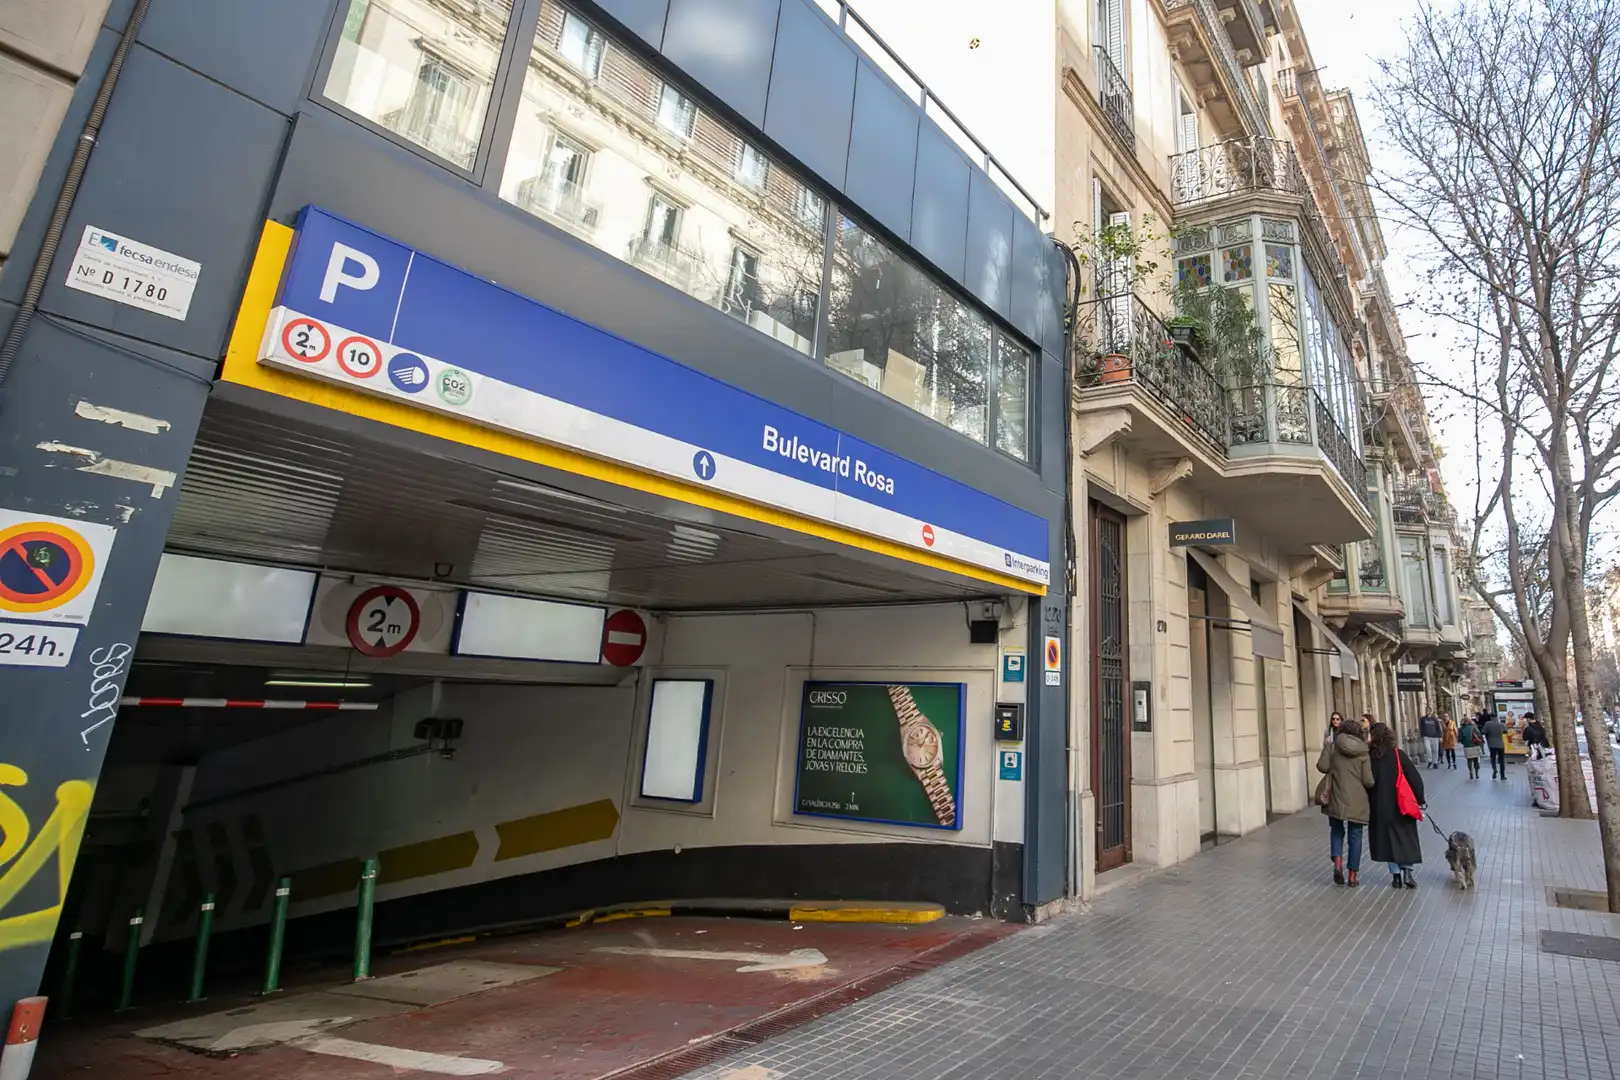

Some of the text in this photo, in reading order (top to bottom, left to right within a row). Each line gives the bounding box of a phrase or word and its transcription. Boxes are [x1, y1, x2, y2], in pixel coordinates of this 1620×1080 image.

[319, 241, 380, 304] P
[102, 270, 114, 285] D
[123, 277, 168, 301] 1780
[349, 349, 370, 366] 10
[443, 377, 465, 391] CO2
[763, 424, 894, 495] Bulevard Rosa
[1175, 531, 1230, 541] GERARD DAREL
[1012, 557, 1048, 580] Interparking
[809, 690, 847, 705] CRISSO
[808, 726, 865, 738] LA EXCELENCIA
[807, 737, 864, 750] EN LA COMPRA
[806, 749, 865, 762] DE DIAMANTES,
[805, 760, 868, 774] JOYAS Y RELOJES
